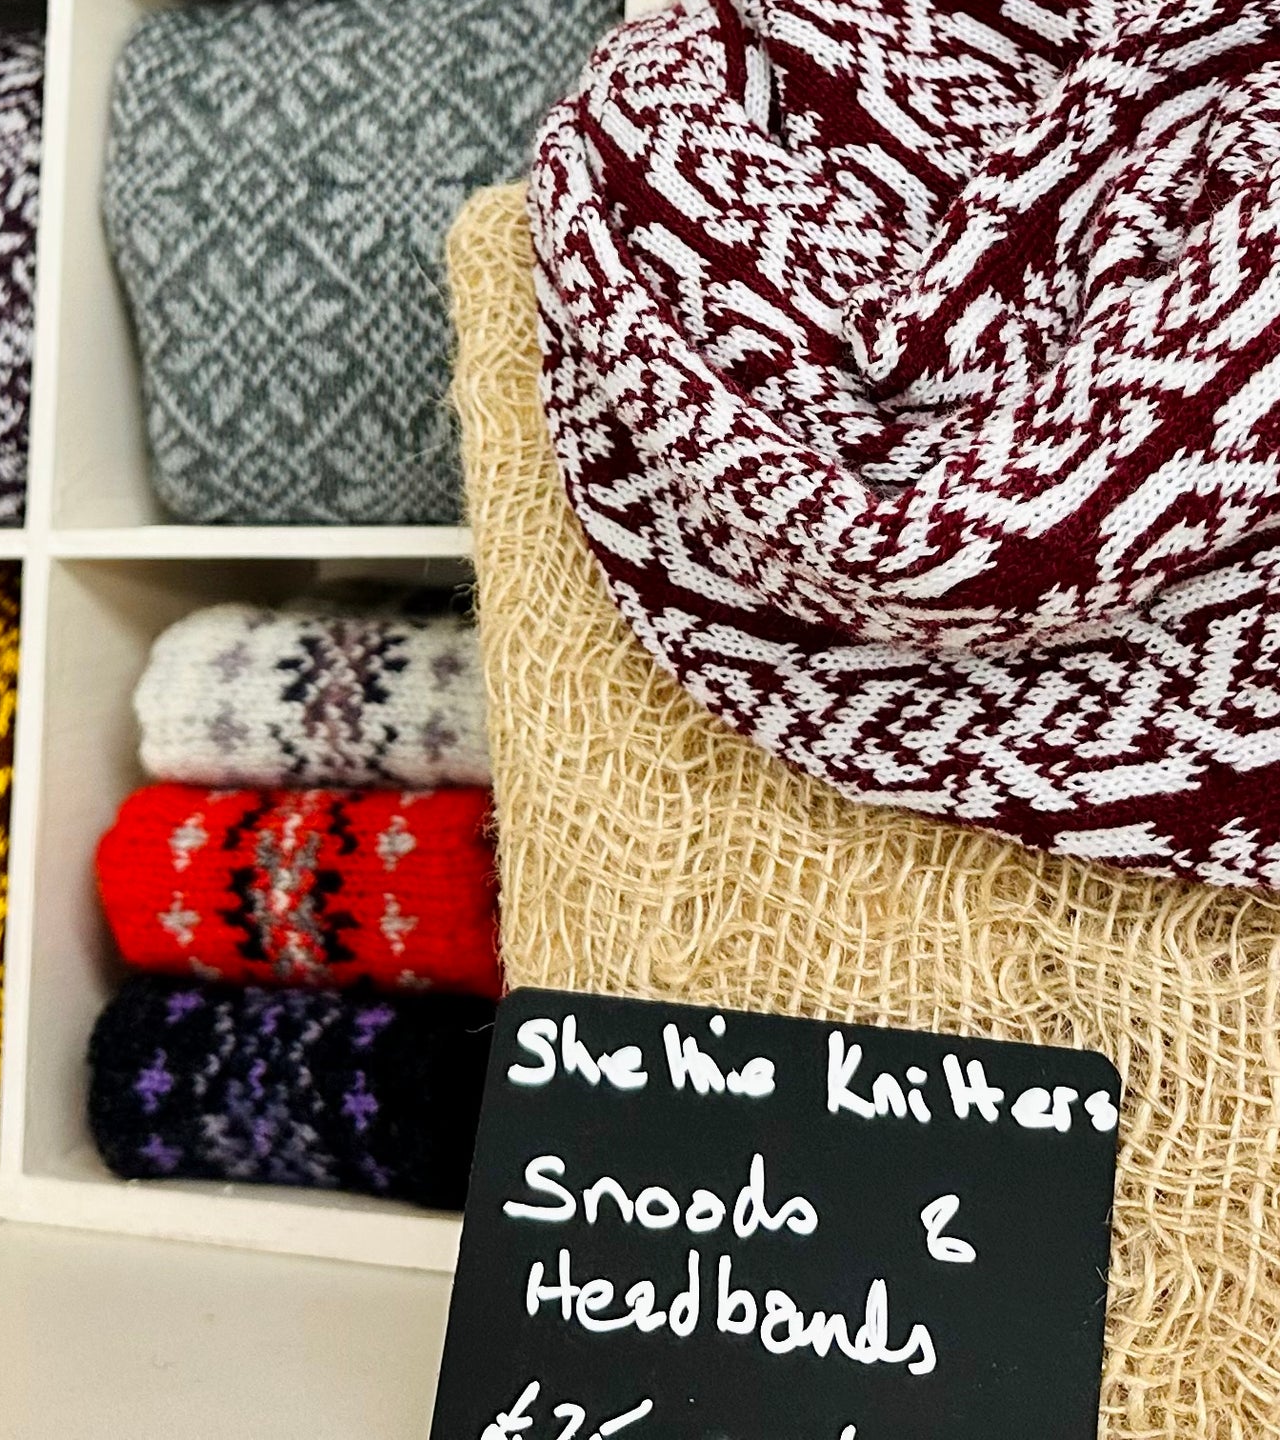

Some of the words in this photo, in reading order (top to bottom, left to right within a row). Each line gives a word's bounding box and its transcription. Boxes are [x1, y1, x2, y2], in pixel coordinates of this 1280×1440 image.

[826, 1030, 1119, 1133] Knitters
[503, 1152, 819, 1239] Snoods
[526, 1248, 938, 1375] Headbands
